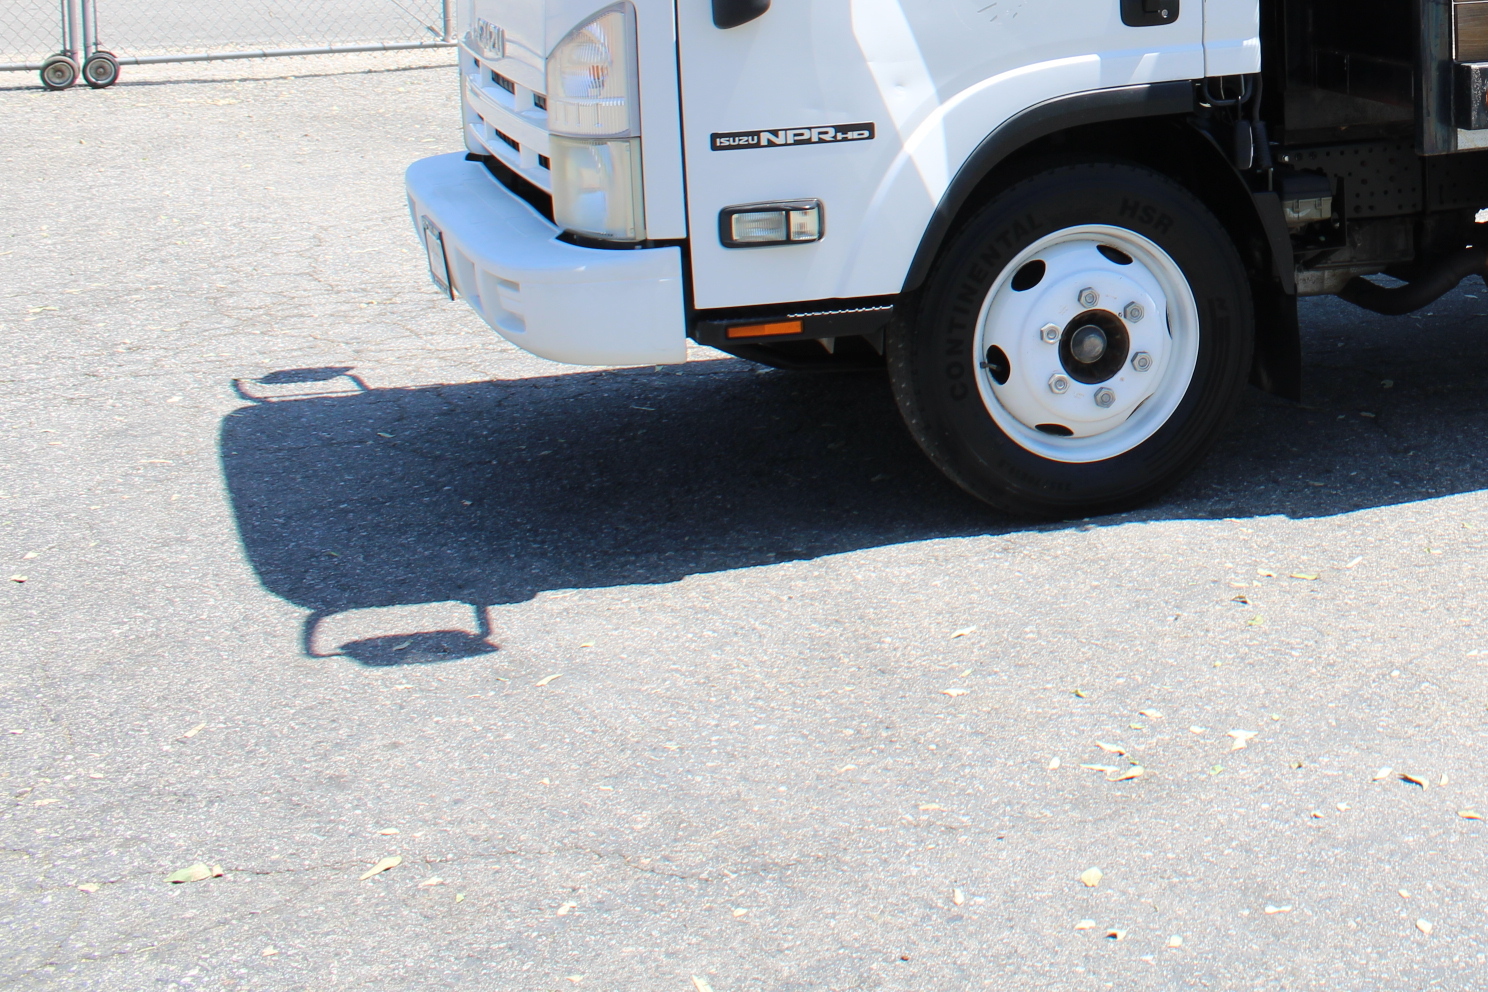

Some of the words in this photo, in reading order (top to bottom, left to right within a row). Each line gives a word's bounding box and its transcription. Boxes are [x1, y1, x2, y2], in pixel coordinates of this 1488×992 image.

[716, 135, 758, 147] ISUZU
[759, 126, 836, 146] NPR
[836, 129, 870, 141] HD
[1118, 196, 1175, 236] HSR
[945, 212, 1044, 402] CONTINENTAL
